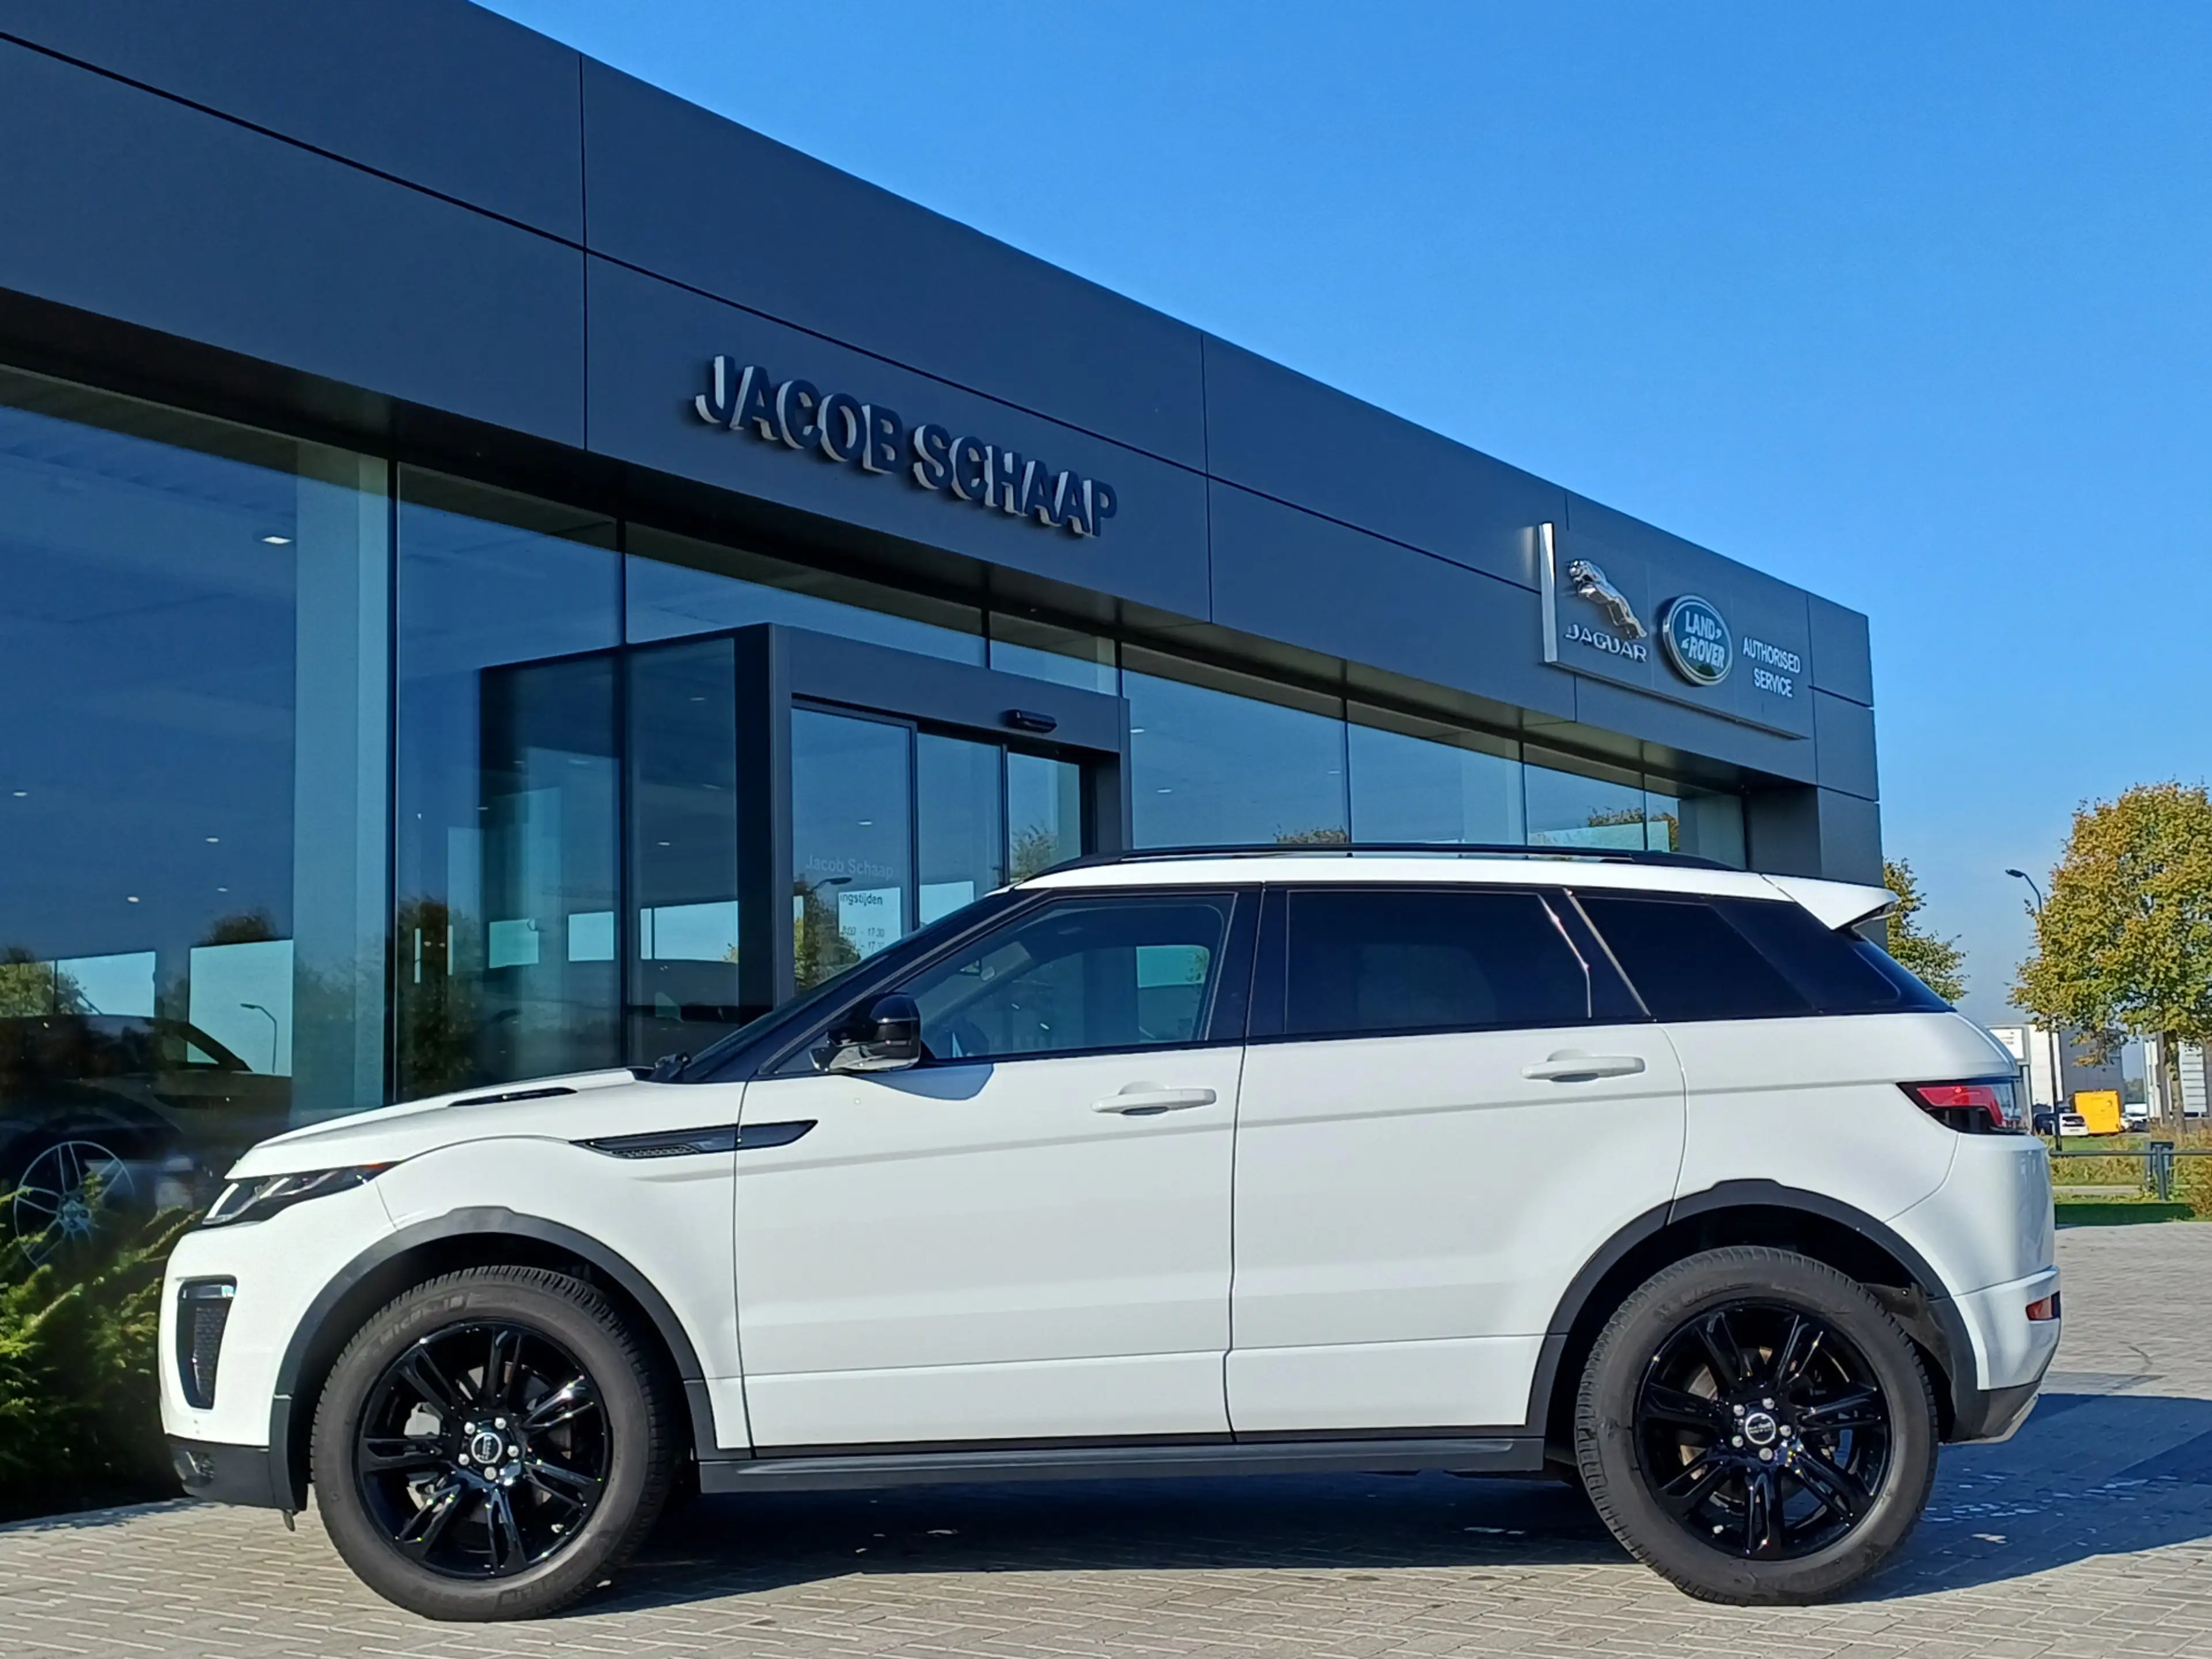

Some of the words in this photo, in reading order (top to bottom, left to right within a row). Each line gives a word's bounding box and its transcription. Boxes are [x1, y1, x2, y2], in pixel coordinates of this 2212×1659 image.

[695, 355, 903, 474] JACOB
[913, 423, 1118, 537] SCHAAP
[1685, 610, 1715, 641] LAND
[1565, 624, 1647, 662] JAGUAR
[1688, 635, 1725, 668] ROVER
[1743, 636, 1801, 674] AUTHORISED
[1753, 667, 1793, 698] SERVICE
[806, 854, 844, 873] Jacob
[848, 858, 893, 881] Schaap
